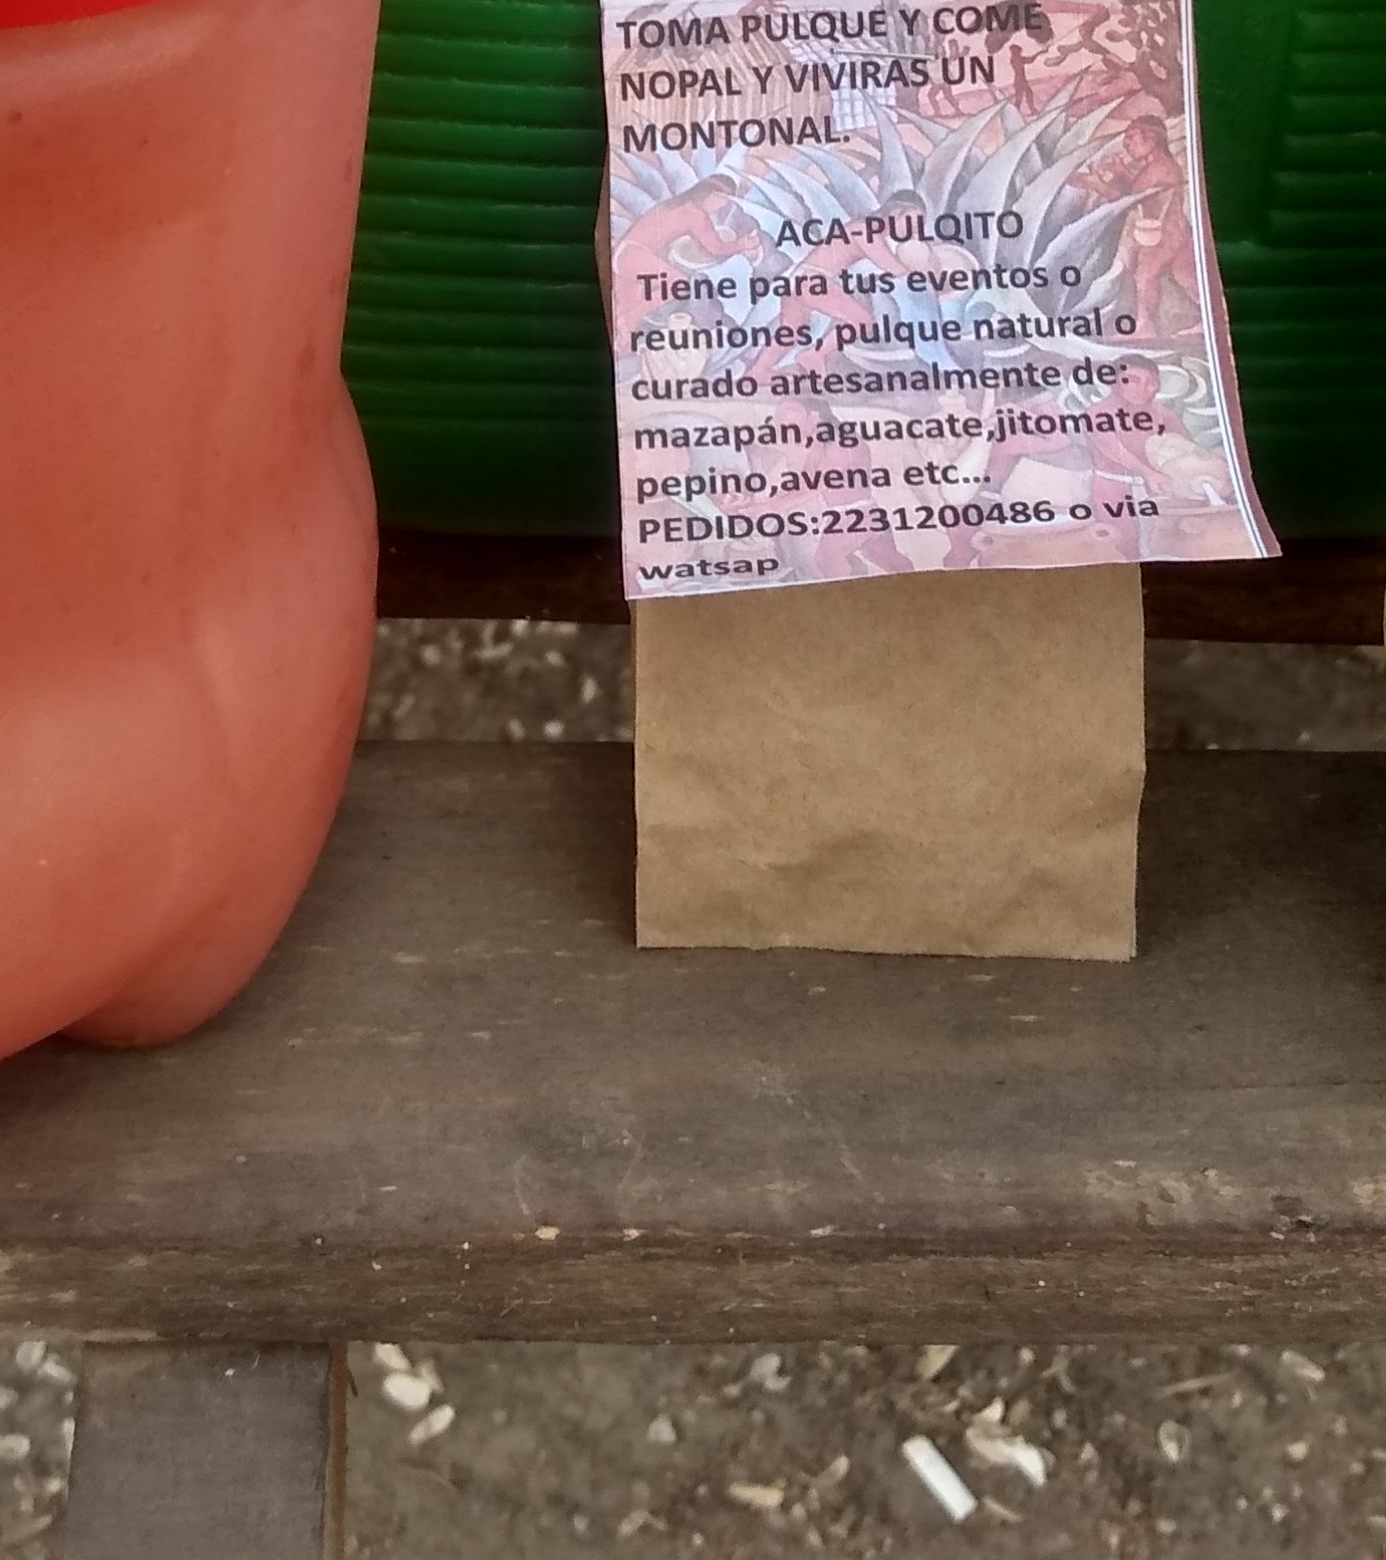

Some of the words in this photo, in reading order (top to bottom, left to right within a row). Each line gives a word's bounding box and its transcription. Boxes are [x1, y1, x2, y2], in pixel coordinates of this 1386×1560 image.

[617, 18, 729, 50] TOMA
[741, 9, 886, 45] PULQUE
[900, 9, 922, 35] Y
[933, 3, 1043, 35] COME
[620, 68, 741, 101] NOPAL
[753, 66, 773, 93] Y
[789, 59, 929, 92] VIVIRAS
[942, 55, 995, 86] UN
[623, 117, 851, 153] MONTONAL.
[775, 211, 1024, 248] ACA-PULQITO
[637, 273, 737, 303] Tiene
[749, 272, 830, 304] para
[838, 269, 895, 296] tus
[906, 261, 1048, 293] eventos
[1060, 268, 1081, 288] o
[630, 322, 823, 352] reuniones,
[835, 313, 961, 346] pulque
[973, 310, 1102, 340] natural
[1115, 314, 1136, 336] o
[632, 371, 757, 402] curado
[770, 363, 1061, 397] artesanalmente
[1071, 359, 1130, 388] de:
[903, 460, 992, 490] etc...
[1069, 504, 1091, 522] o
[1103, 497, 1159, 520] via
[639, 554, 780, 582] watsap
